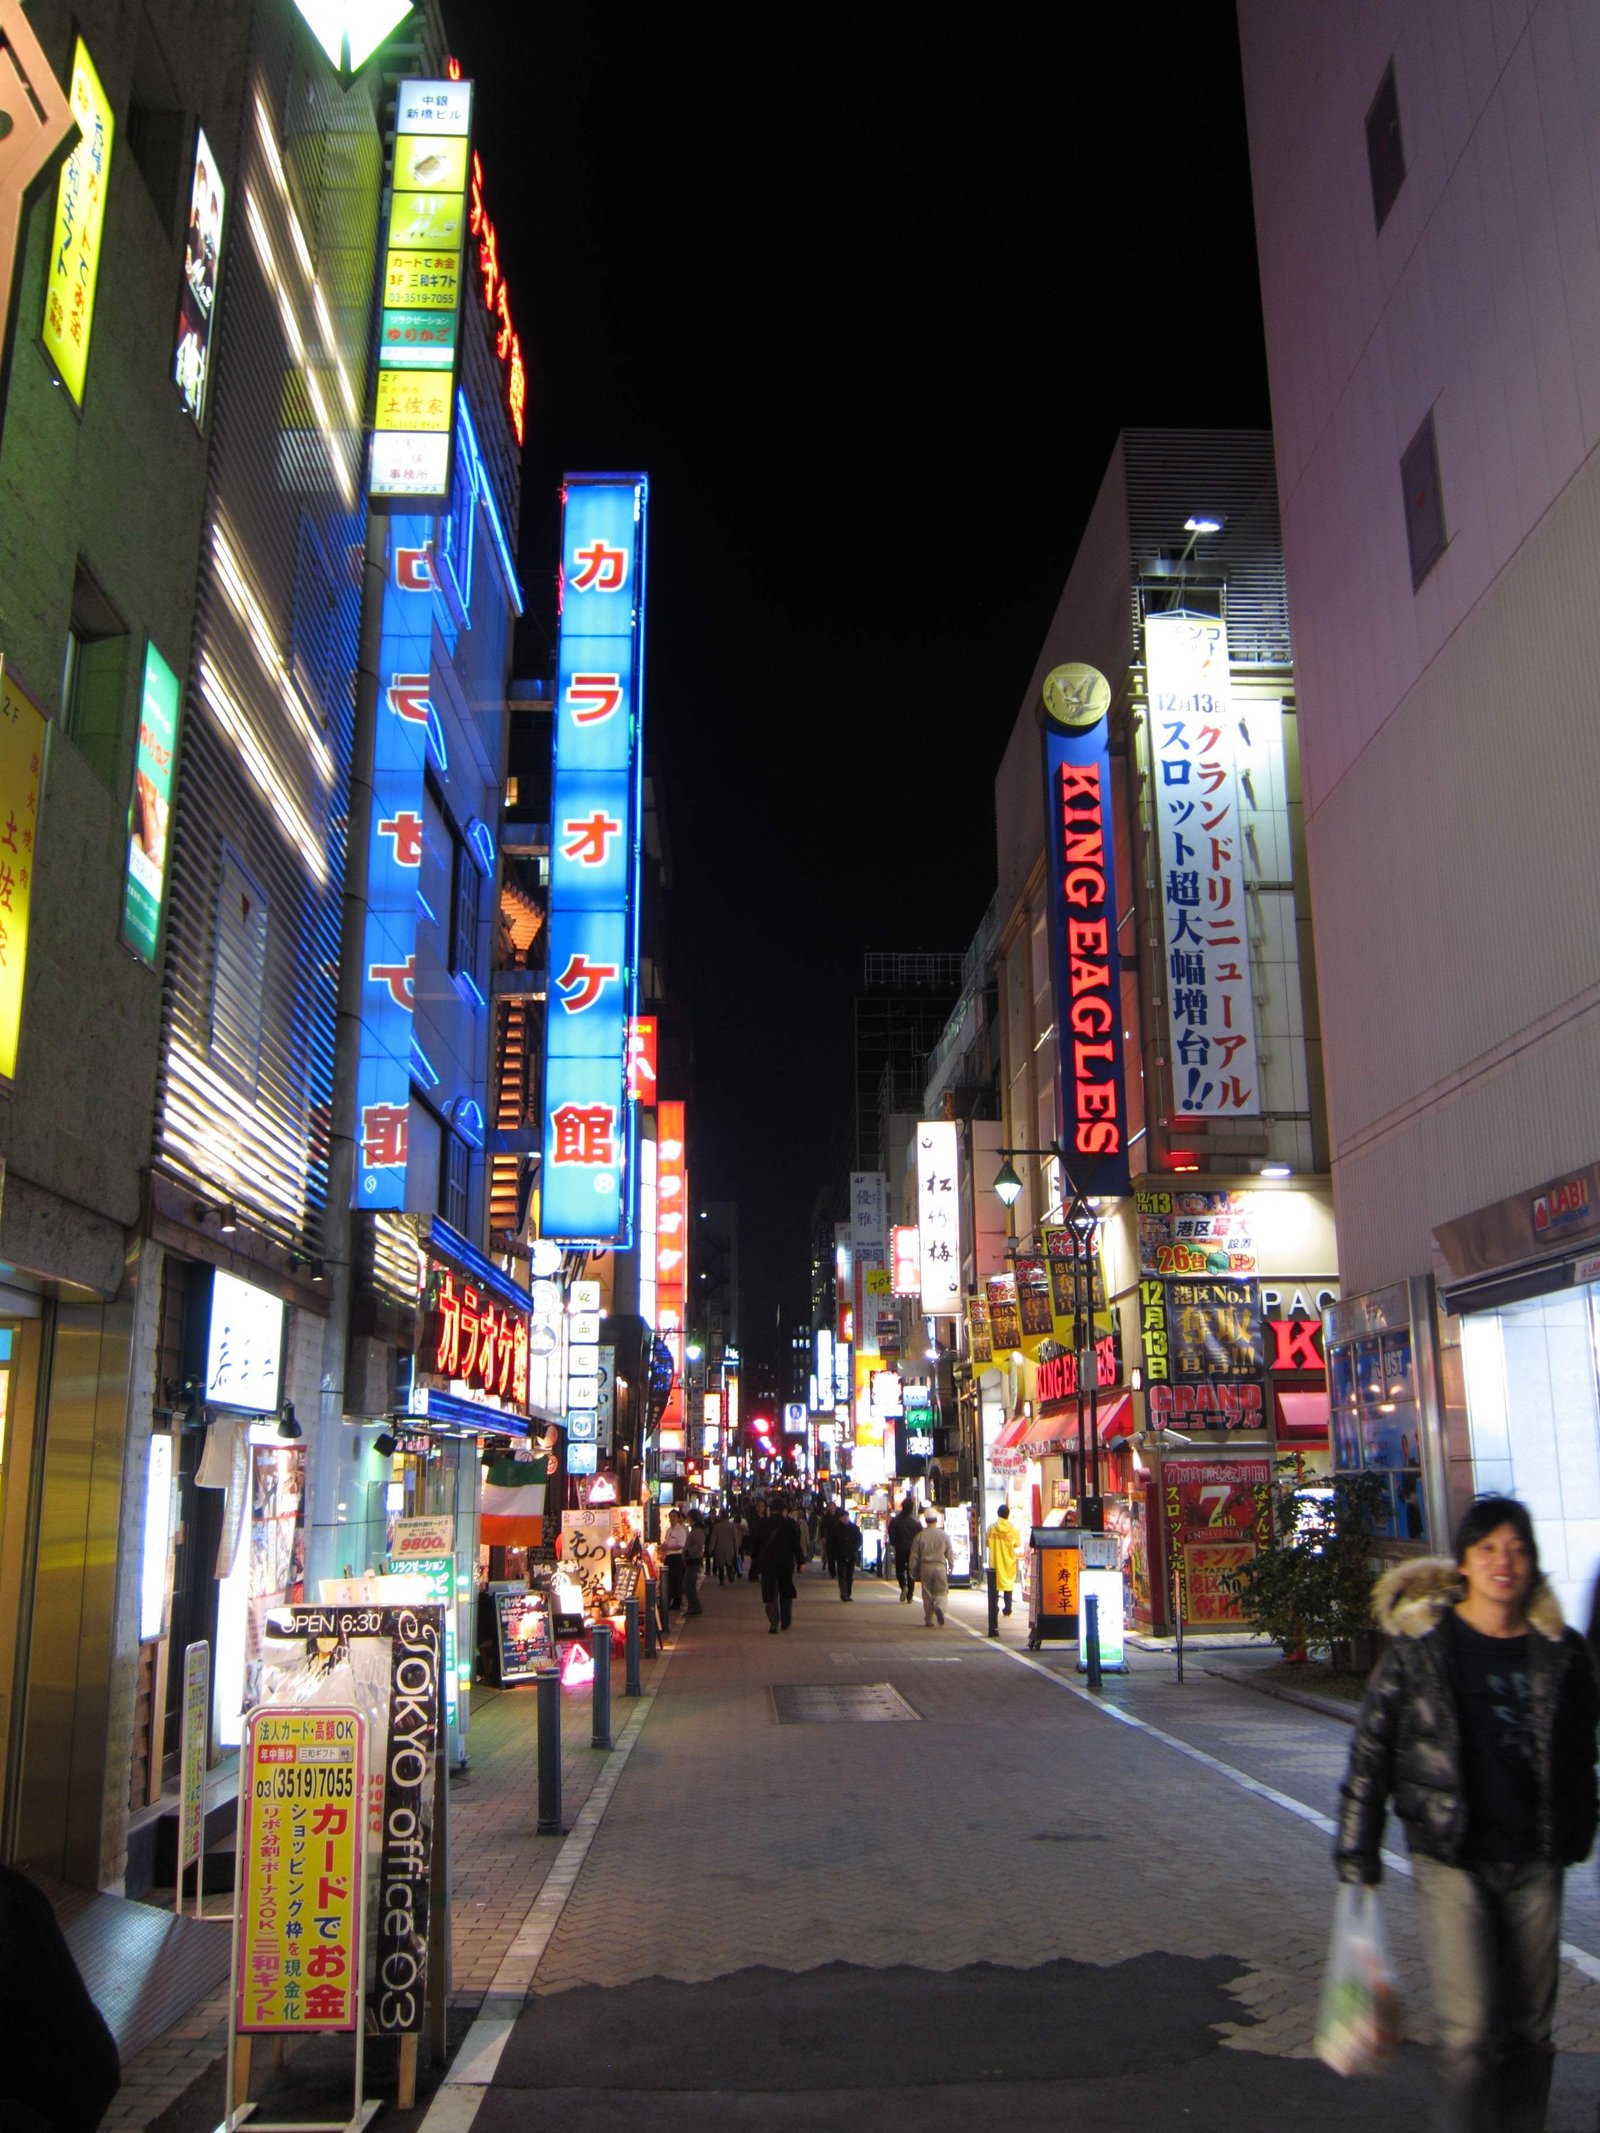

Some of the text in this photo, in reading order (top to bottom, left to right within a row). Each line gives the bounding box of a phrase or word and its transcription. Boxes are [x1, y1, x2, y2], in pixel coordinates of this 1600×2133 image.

[406, 108, 462, 120] 新橋ビル
[421, 95, 449, 107] 中銀
[389, 274, 457, 288] 3F 三和ギフト
[389, 291, 455, 304] 03-3519-7055
[1156, 693, 1226, 714] 12月13日
[549, 539, 628, 1167] カラオケ館
[1196, 722, 1254, 1111] グランドリニューアル
[1060, 761, 1120, 1155] KING EAGLES
[925, 1170, 954, 1264] 松竹梅
[437, 1271, 528, 1405] カラオケ館
[1138, 1280, 1168, 1380] 12月13日
[1035, 1358, 1064, 1402] KING
[1149, 1384, 1262, 1412] GRAND
[1151, 1411, 1263, 1430] リニューアル
[390, 1559, 447, 1574] リラクゼーション
[1056, 1567, 1074, 1613] 寿毛平
[280, 1614, 335, 1634] OPEN
[260, 1720, 354, 1741] 法人カード・高額OK
[260, 1748, 294, 1760] 年中無休
[301, 1749, 336, 1759] 三和ギフト
[256, 1767, 353, 1800] 03(3519)7055
[384, 1808, 425, 1937] office
[283, 1803, 308, 2021] ショッピング枠を現金化
[304, 1803, 349, 2020] カードでお金
[251, 1938, 281, 2022] 三和ギフト
